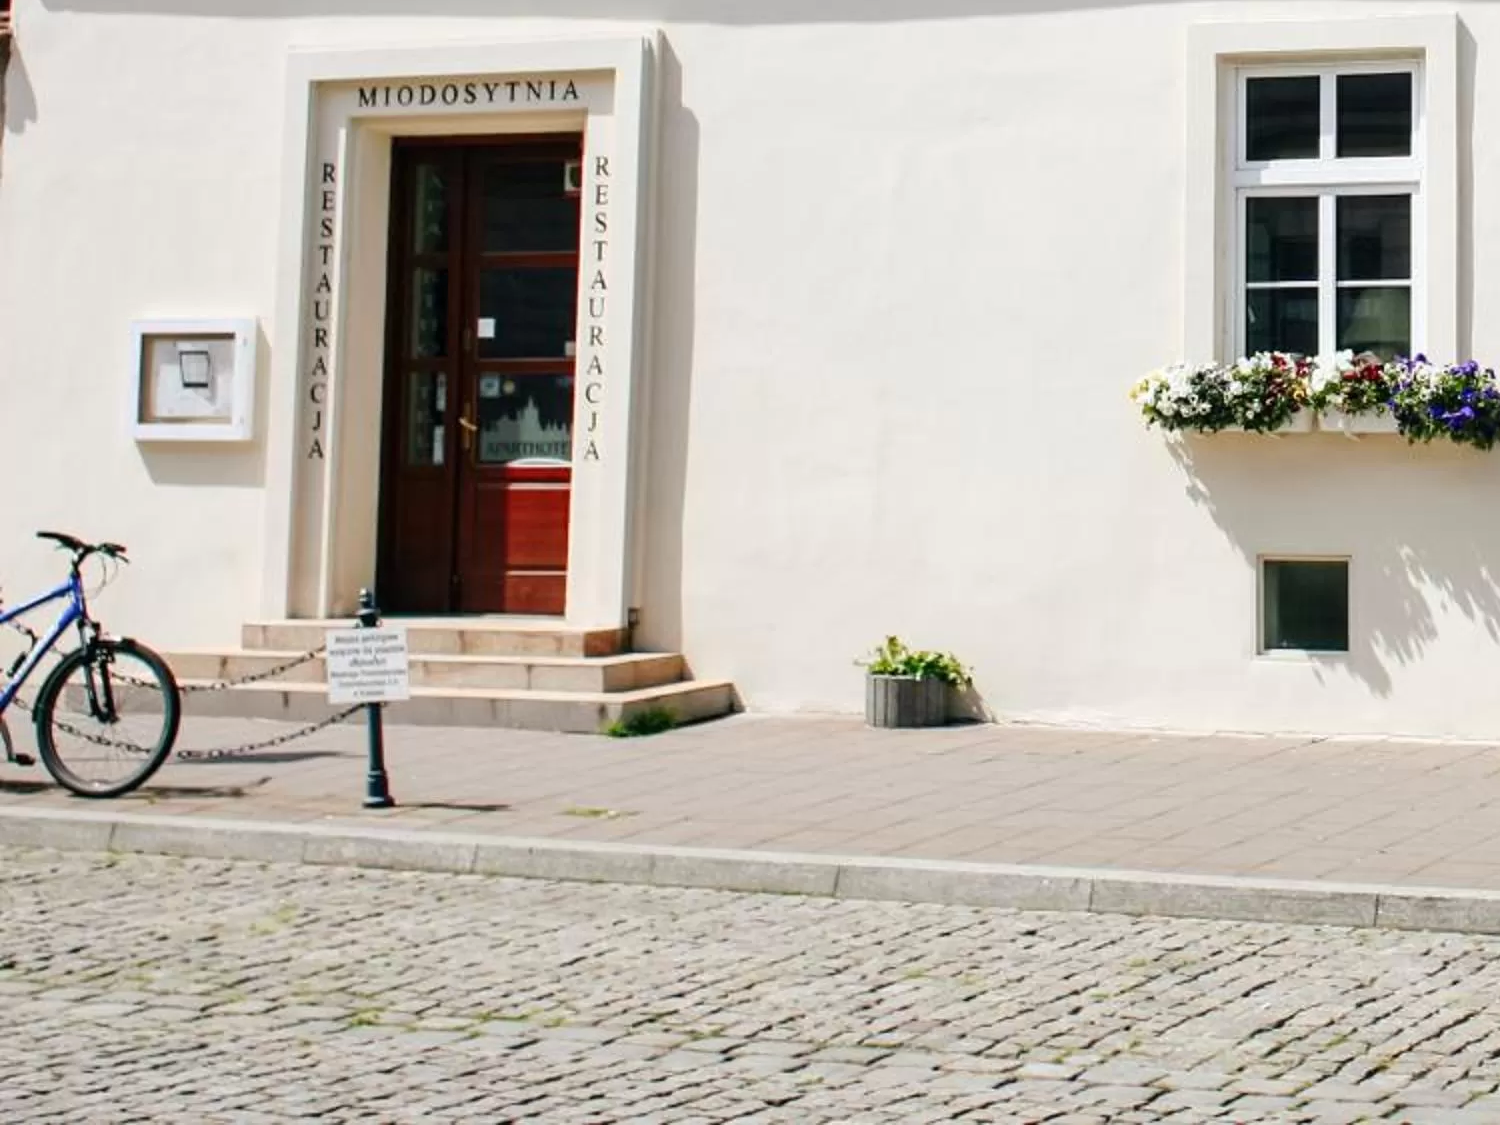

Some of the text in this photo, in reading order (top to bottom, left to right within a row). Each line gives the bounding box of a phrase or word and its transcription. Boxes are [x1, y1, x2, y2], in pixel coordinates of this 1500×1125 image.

[358, 79, 579, 107] MIODOSYTNIA
[308, 162, 336, 459] RESTAURACJA
[583, 156, 610, 461] RESTAURACJA
